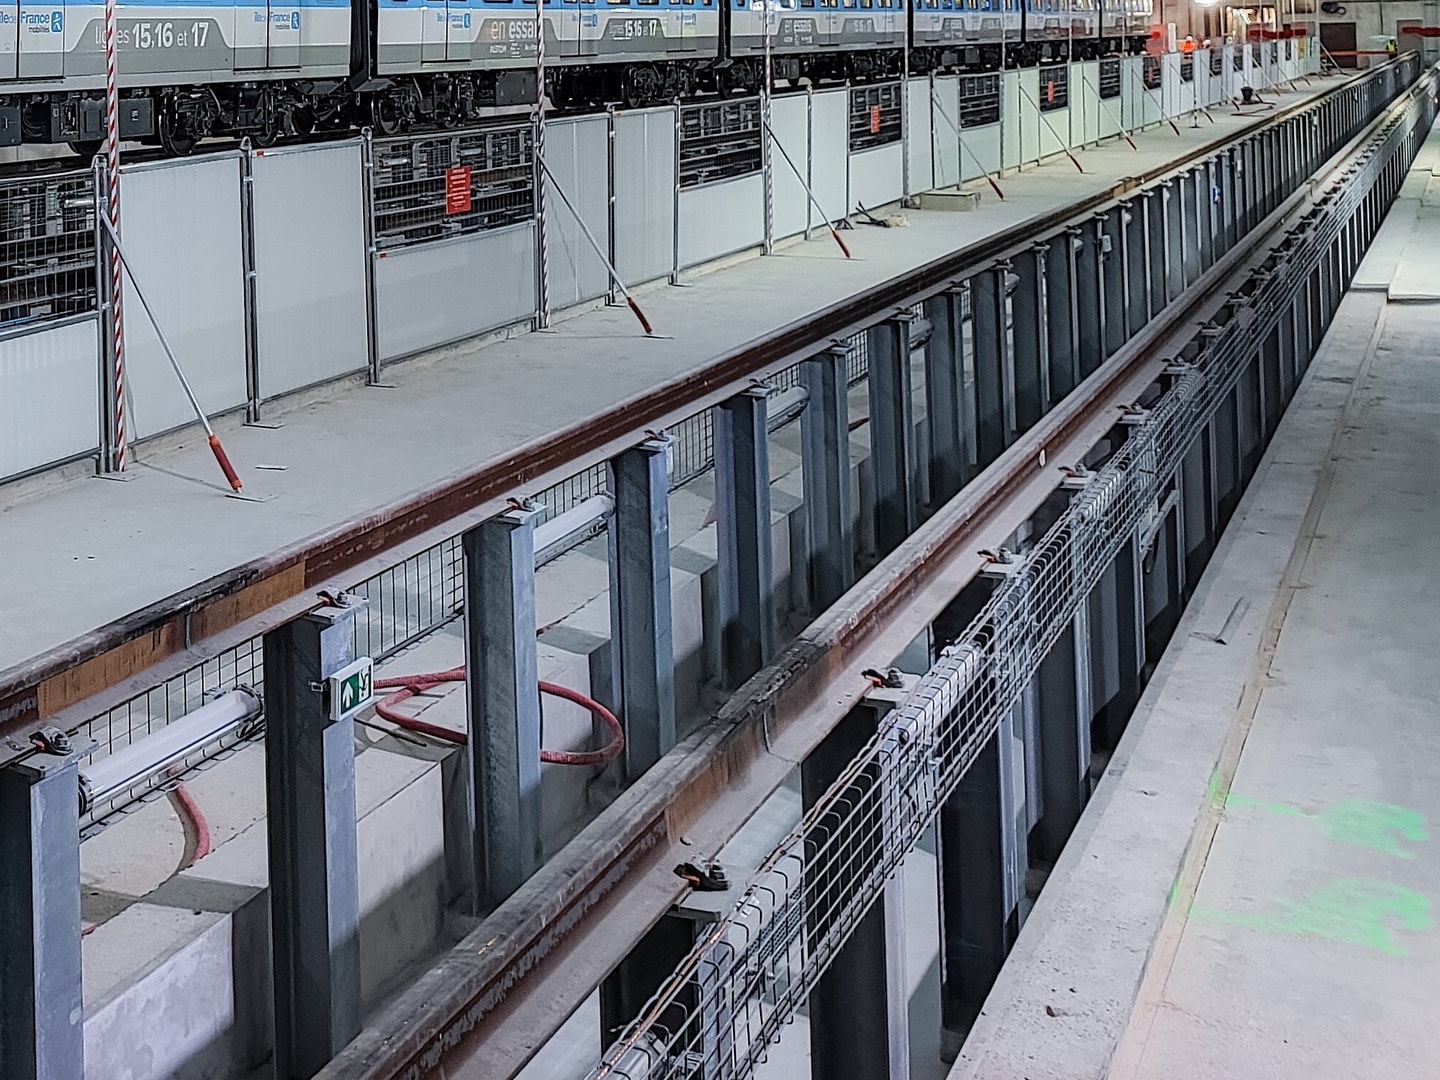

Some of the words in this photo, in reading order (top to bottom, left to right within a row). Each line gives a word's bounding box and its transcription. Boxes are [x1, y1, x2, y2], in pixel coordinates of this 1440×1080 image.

[21, 11, 50, 24] France
[95, 26, 130, 48] liges
[132, 22, 173, 48] 15,16
[177, 30, 188, 46] et
[191, 22, 209, 47] 17
[492, 21, 506, 40] en
[509, 20, 539, 39] essai
[649, 20, 657, 36] 17
